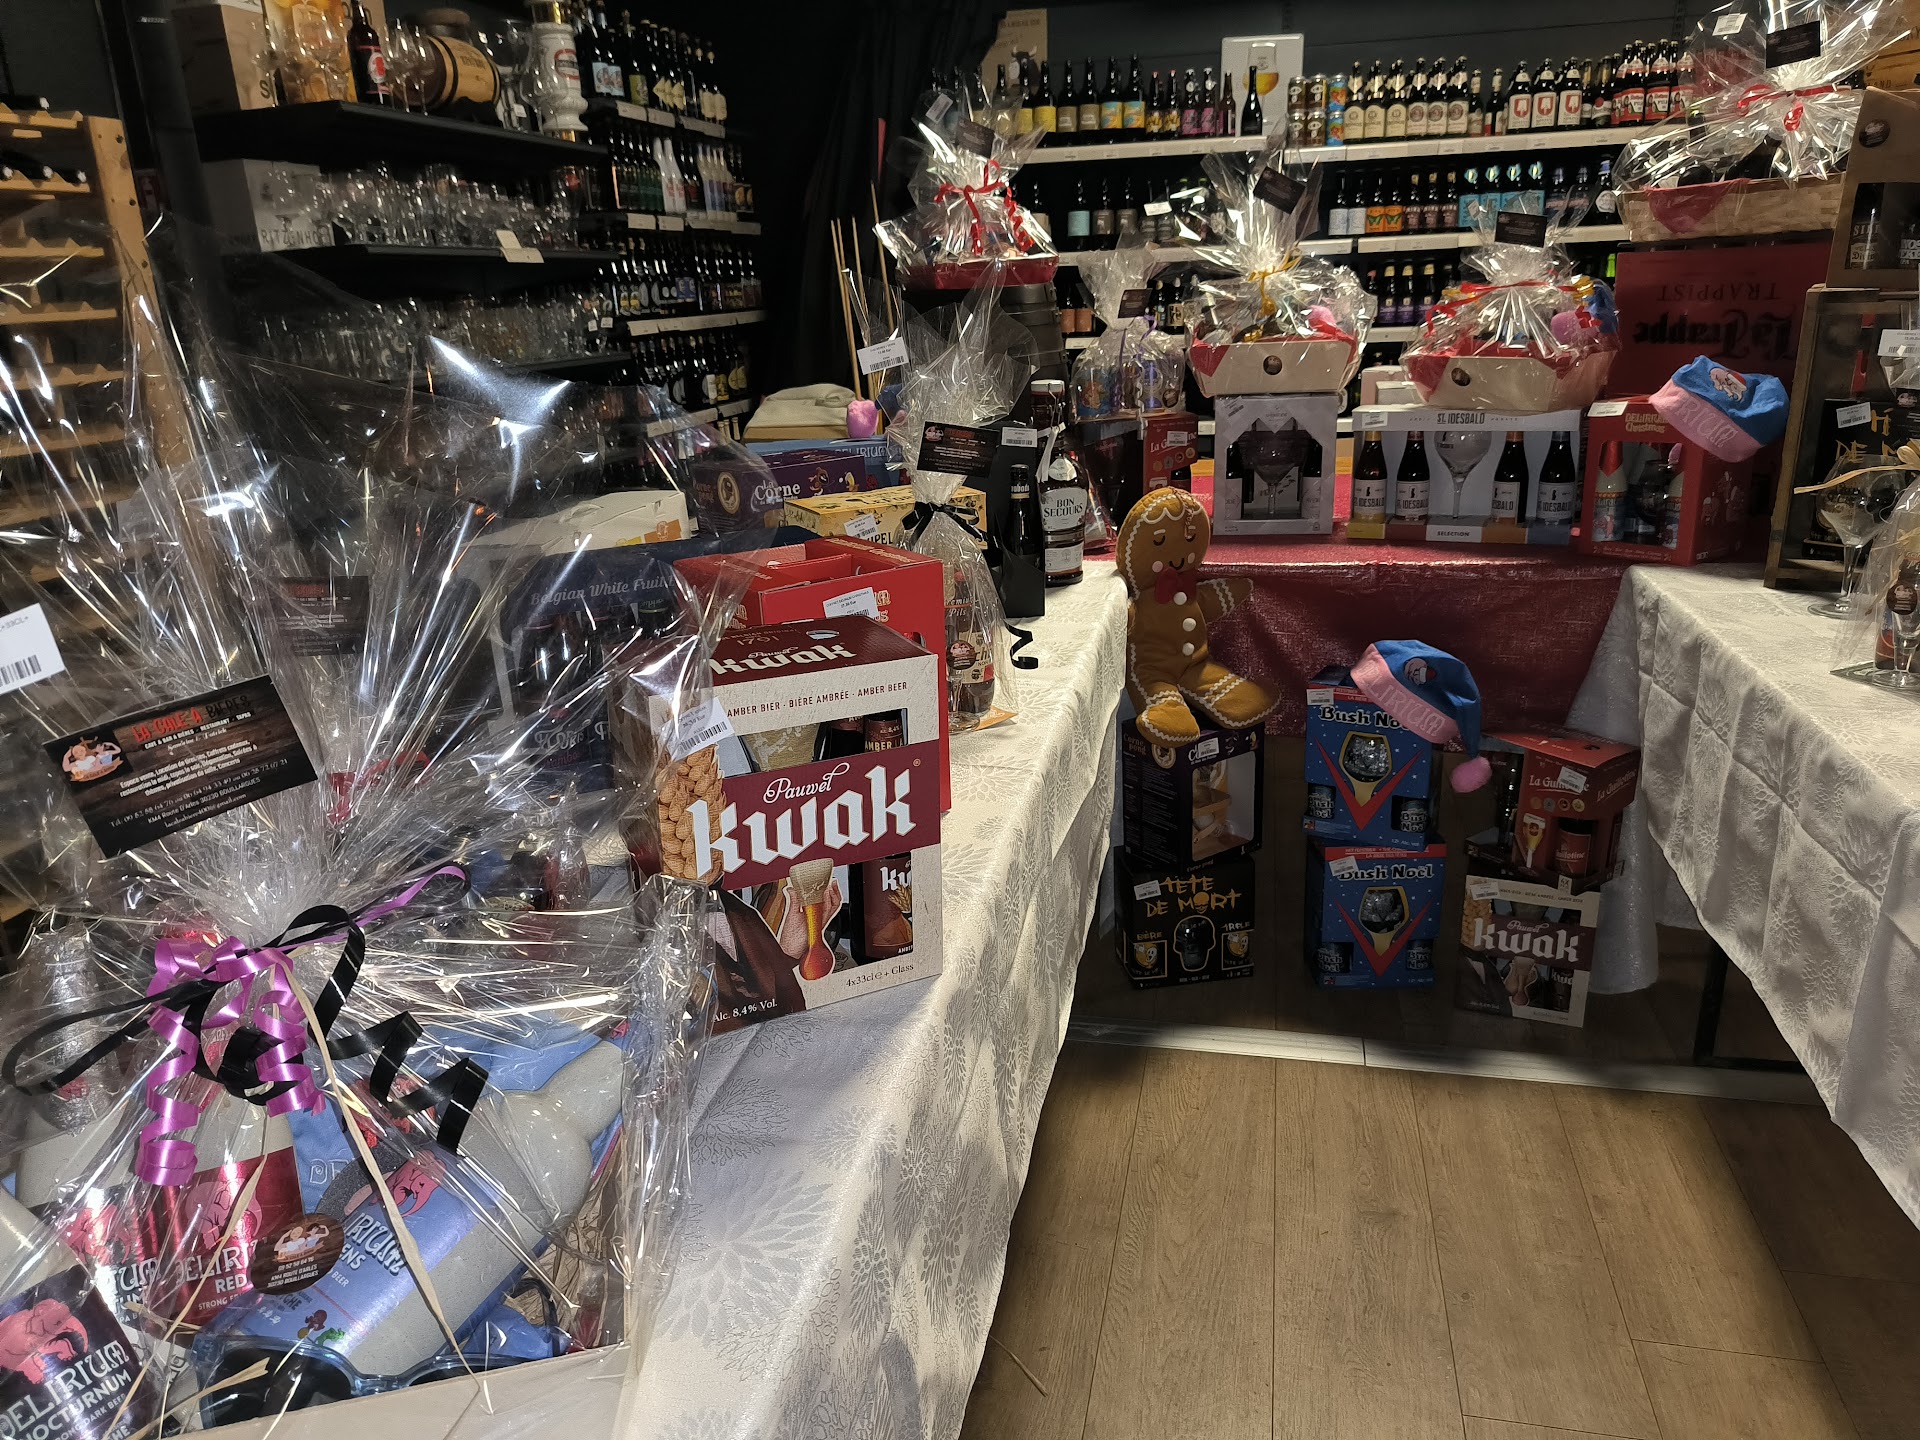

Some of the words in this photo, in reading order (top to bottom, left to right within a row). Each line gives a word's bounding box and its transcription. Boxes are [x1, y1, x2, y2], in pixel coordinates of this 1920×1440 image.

[1656, 282, 1782, 301] TRAPPIST
[1447, 412, 1485, 425] IDESBALD
[755, 484, 801, 501] Corne
[1043, 503, 1083, 518] SECOURS
[1056, 498, 1075, 509] BON
[589, 581, 630, 597] White
[948, 608, 967, 617] Pils
[727, 704, 757, 718] AMBER
[760, 702, 781, 714] BIER
[816, 690, 850, 705] AMBRÉE
[857, 685, 886, 698] AMBER
[887, 681, 908, 694] BEER
[1319, 705, 1371, 726] Bush
[1374, 711, 1411, 731] No
[131, 725, 152, 742] LA
[153, 713, 191, 735] CALE
[864, 740, 893, 752] AMBER
[217, 757, 240, 769] Concerts
[762, 761, 851, 804] Pauwel
[1529, 775, 1542, 787] La
[1144, 900, 1169, 918] DE
[891, 963, 914, 977] Glass
[732, 1004, 758, 1019] 8,4%
[760, 998, 778, 1011] Vol.
[215, 1273, 248, 1294] RED
[282, 1269, 320, 1284] BOUILLARGUES
[198, 1296, 228, 1311] STRONG
[0, 1339, 131, 1439] DELIRIUM
[83, 1406, 108, 1427] DARK
